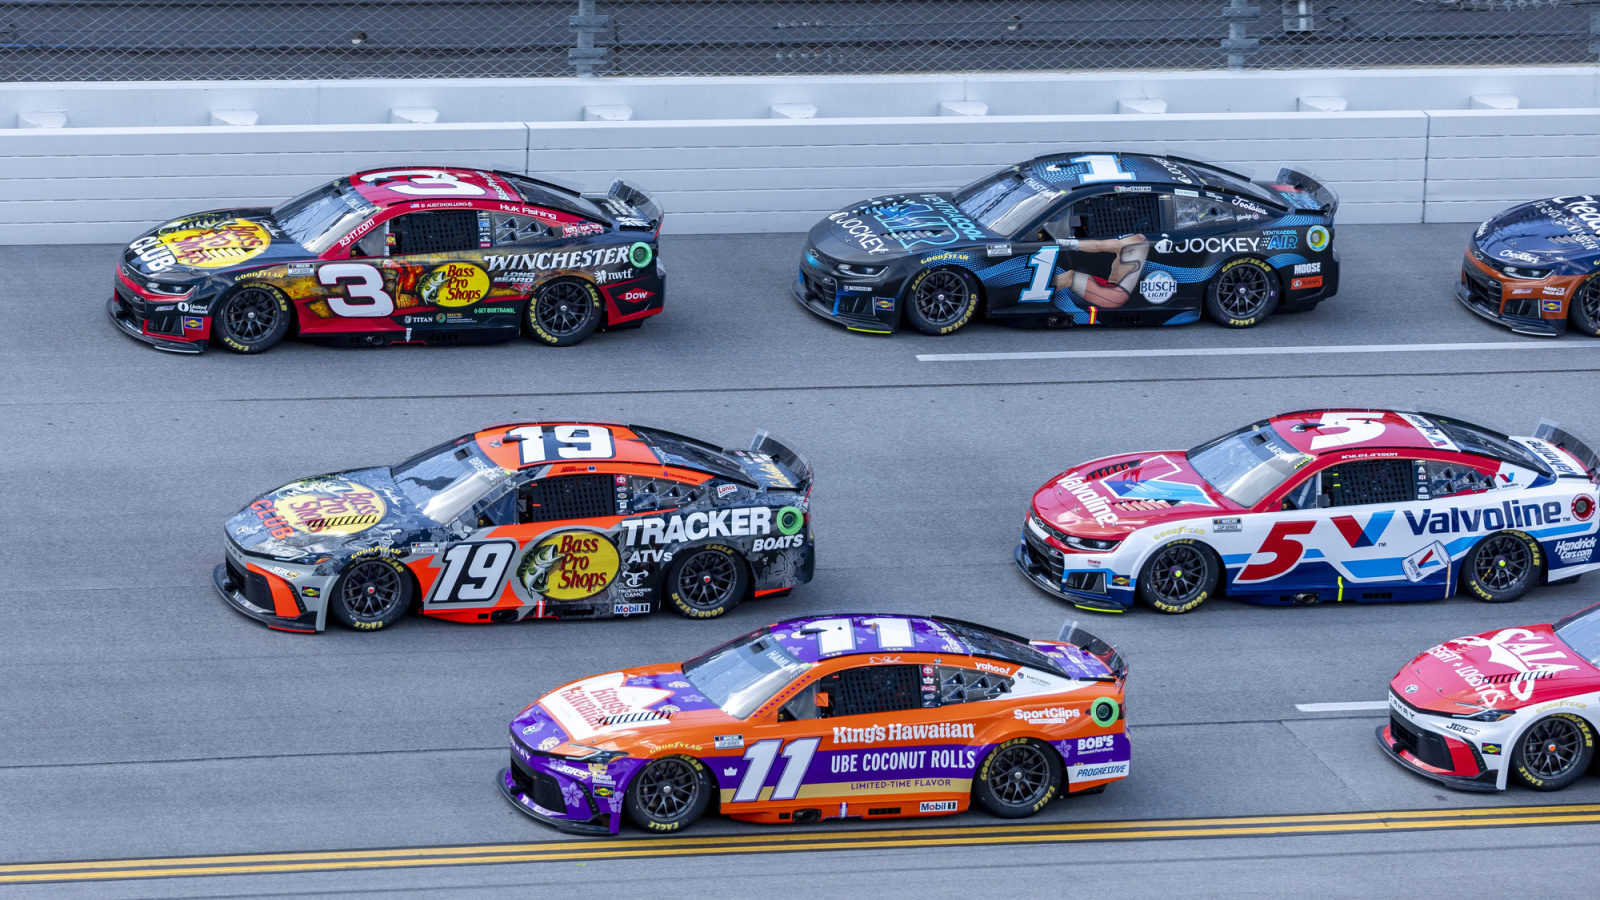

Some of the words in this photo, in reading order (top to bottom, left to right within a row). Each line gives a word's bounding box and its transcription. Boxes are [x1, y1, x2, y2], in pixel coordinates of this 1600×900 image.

[1070, 154, 1136, 184] 1
[358, 169, 487, 196] 3
[500, 204, 520, 213] Huk
[522, 206, 557, 220] Fishing
[1232, 195, 1267, 216] Tootsies
[226, 226, 263, 248] Bass
[836, 217, 889, 256] JOCKEY
[1176, 237, 1259, 253] JOCKEY
[1267, 235, 1298, 250] AIR
[129, 236, 177, 271] CLUB
[483, 246, 630, 272] WINCHESTER
[921, 253, 969, 265] GOODYEAR
[1500, 250, 1539, 264] Cheddar's
[447, 264, 475, 279] Bass
[1018, 246, 1060, 302] 1
[1221, 257, 1272, 273] GOODYEAR
[1294, 262, 1321, 274] MOOSE
[234, 269, 285, 282] GOODYEAR
[447, 276, 469, 290] Pro
[911, 270, 931, 291] EAGLE
[317, 263, 394, 318] 3
[446, 286, 481, 303] Shops
[585, 283, 600, 308] EAGLE
[1141, 281, 1176, 293] BUSCH
[527, 297, 559, 344] GOODYEAR
[940, 293, 977, 334] GOODYEAR
[1228, 317, 1256, 327] EAGLE
[223, 336, 250, 352] EAGLE
[1310, 412, 1386, 450] 5
[508, 425, 614, 462] 19
[718, 485, 736, 494] Lance
[317, 494, 349, 514] Pro
[343, 491, 382, 515] Bass
[1057, 472, 1118, 528] Valvoline
[250, 499, 295, 540] CLUB
[621, 507, 770, 546] TRACKER
[1403, 500, 1561, 536] Valvoline
[752, 534, 803, 552] BOATS
[1153, 526, 1206, 540] GOODYEAR
[351, 546, 402, 560] GOODYEAR
[560, 534, 598, 554] Bass
[704, 544, 734, 555] EAGLE
[1233, 521, 1317, 583] 5
[1554, 537, 1597, 553] Hendrick
[1560, 548, 1593, 560] Cars.com
[561, 552, 590, 571] Pro
[627, 550, 673, 564] ATVs
[432, 541, 516, 603] 19
[558, 569, 607, 591] Shops
[1469, 580, 1493, 601] EAGLE
[615, 605, 640, 613] Mobil
[671, 591, 724, 618] GOODYEAR
[1154, 591, 1208, 613] GOODYEAR
[353, 620, 384, 630] EAGLE
[817, 616, 917, 655] 11
[975, 662, 1011, 674] yahoo!
[590, 687, 631, 715] King's
[1014, 708, 1080, 723] SportClips
[832, 726, 885, 744] King's
[888, 722, 974, 742] Hawaiian
[1550, 712, 1593, 748] GOODYEAR
[649, 742, 703, 754] GOODYEAR
[1077, 735, 1114, 751] BOB'S
[831, 753, 858, 774] UBE
[863, 751, 928, 772] COCONUT
[931, 750, 975, 770] ROLLS
[981, 738, 1028, 781] GOODYEAR
[732, 737, 821, 803] 11
[1076, 764, 1127, 778] PROGRESSIVE
[1519, 766, 1543, 787] EAGLE
[850, 780, 912, 790] LIMITED-TIME
[915, 778, 951, 787] FLAVOR
[920, 801, 946, 811] Mobil
[1032, 785, 1056, 812] EAGLE
[648, 820, 679, 831] EAGLE
